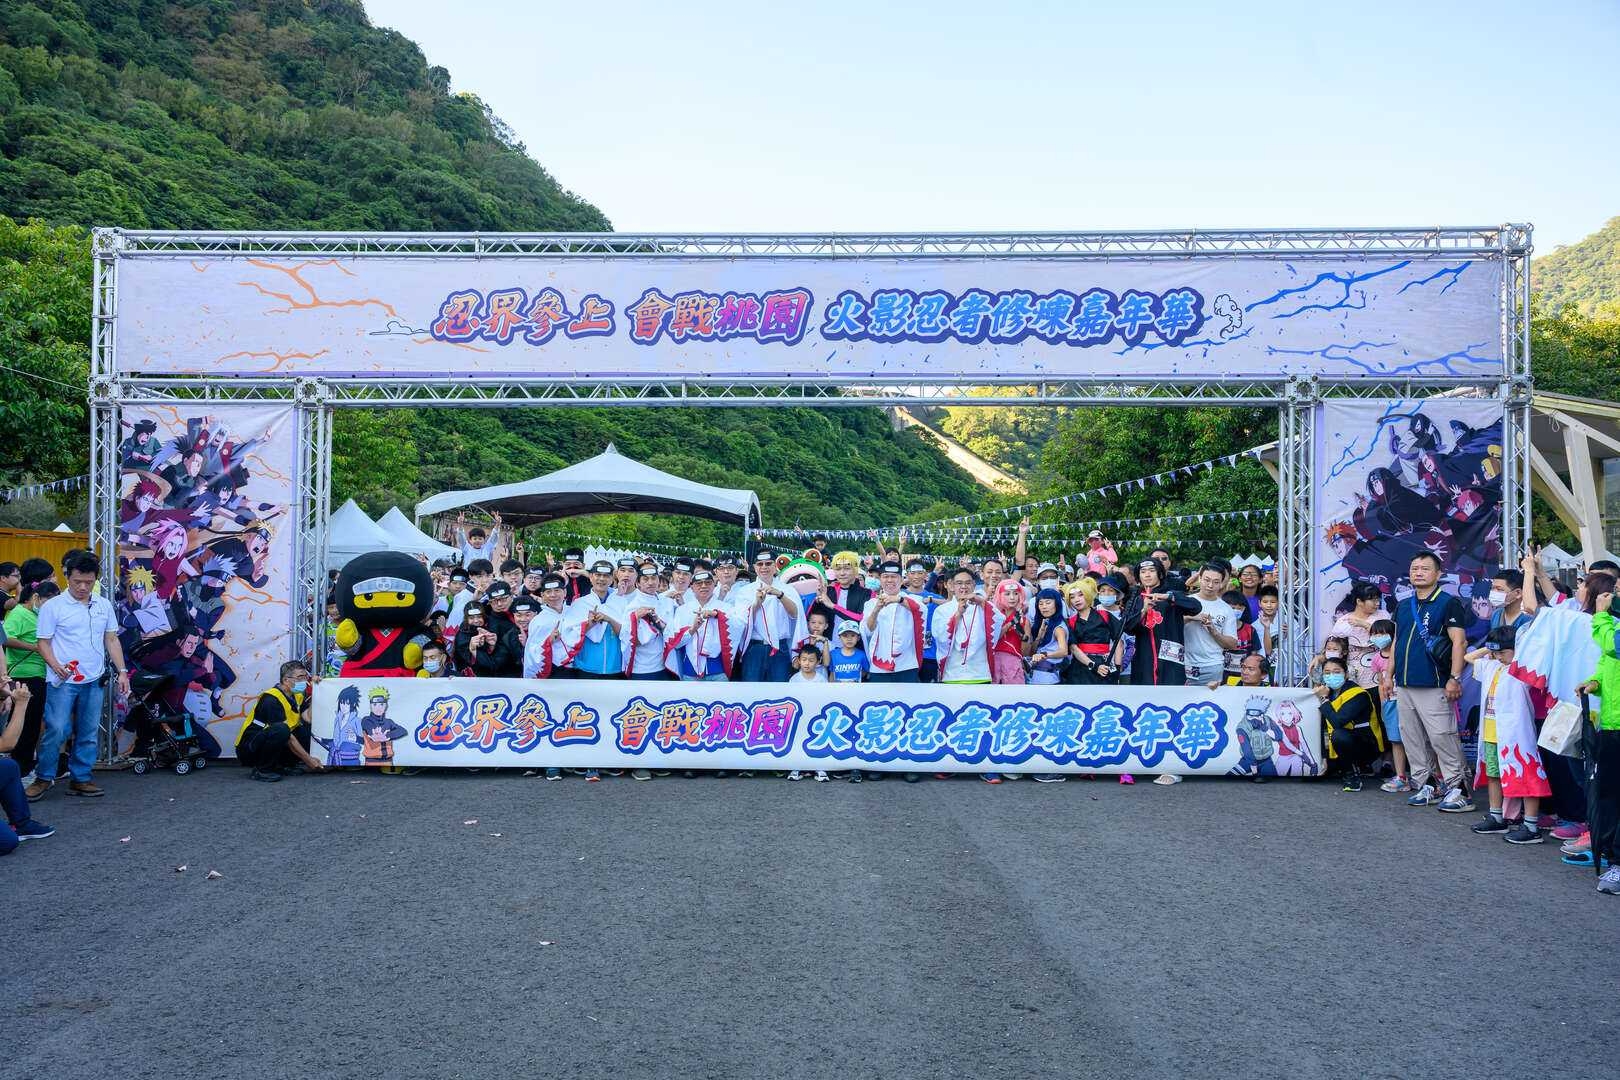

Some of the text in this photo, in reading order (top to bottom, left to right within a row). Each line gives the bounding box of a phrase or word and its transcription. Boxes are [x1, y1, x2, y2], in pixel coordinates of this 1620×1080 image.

[431, 287, 1203, 346] 忍界參上 會戰桃園 火影忍者修煉嘉年華
[415, 694, 1227, 767] 忍界參上 會戰桃園 火影忍者修煉嘉年華
